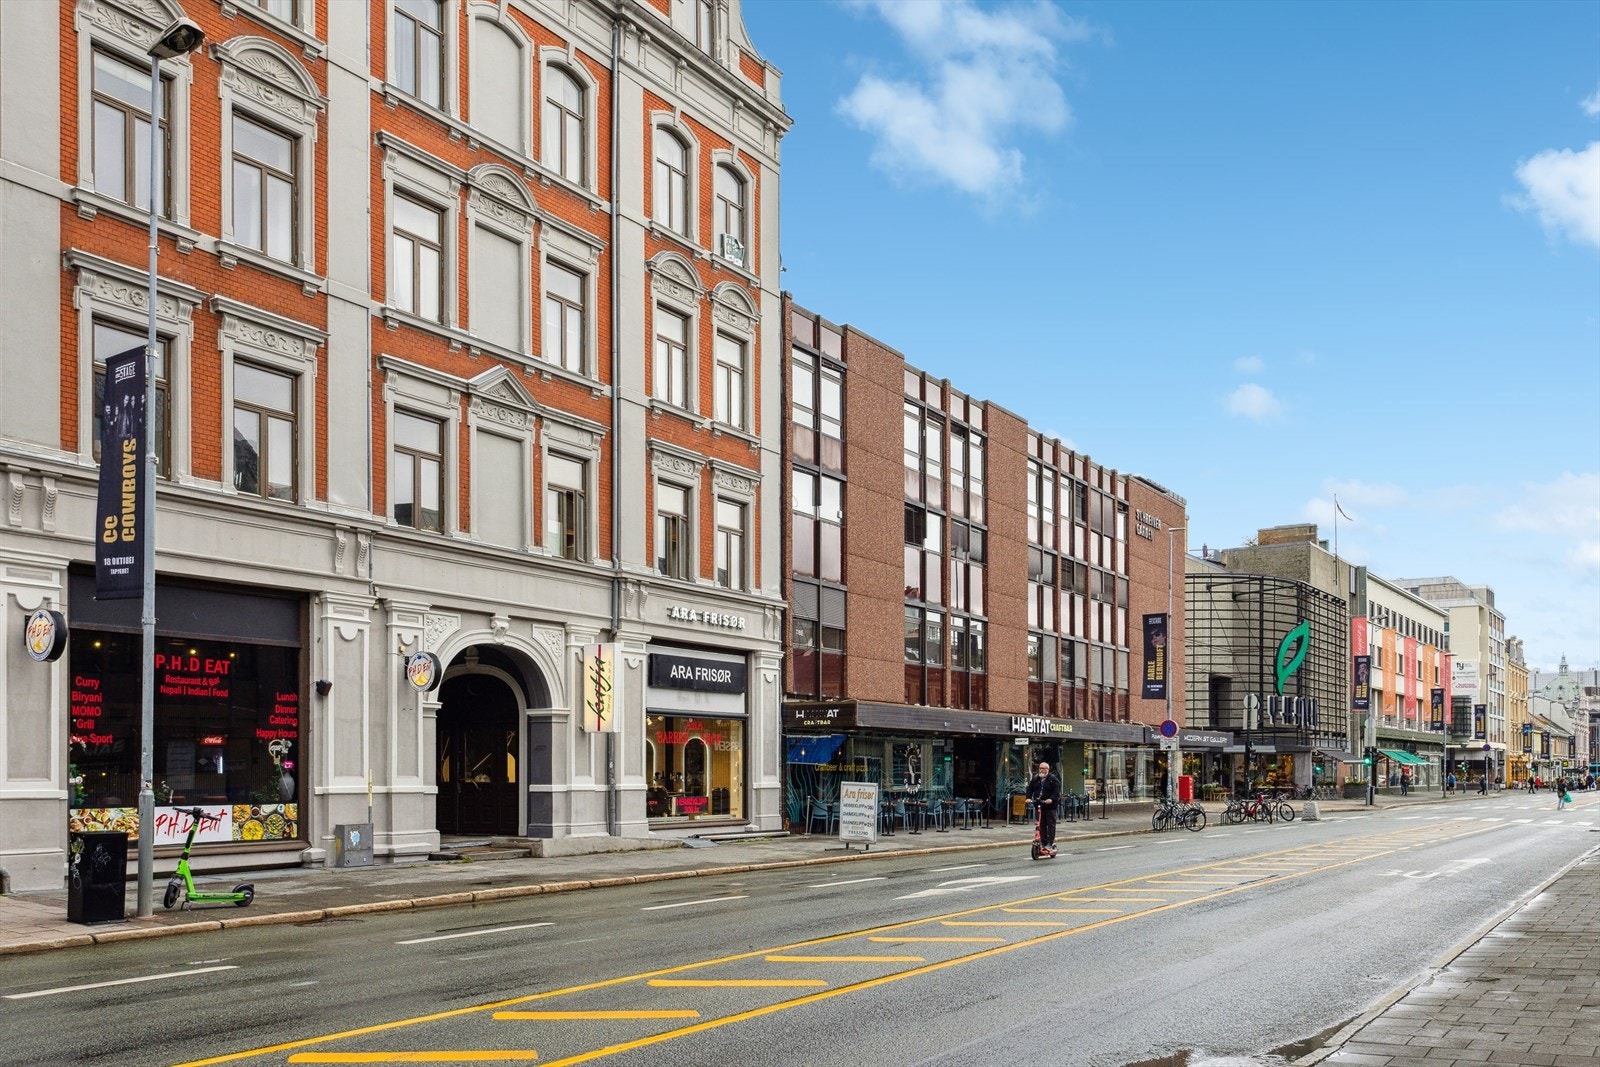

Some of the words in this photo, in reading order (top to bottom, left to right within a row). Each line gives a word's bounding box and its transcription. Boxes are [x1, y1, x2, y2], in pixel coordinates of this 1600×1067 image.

[122, 438, 136, 542] COWBOYS
[104, 514, 118, 544] CC
[671, 606, 697, 622] ARA
[703, 612, 746, 629] FRISØR
[155, 654, 200, 672] P.H.D
[205, 659, 230, 674] EAT
[165, 675, 201, 685] Restaurant
[671, 664, 693, 680] ARA
[695, 666, 732, 683] FRISØR
[75, 676, 100, 690] Curry
[72, 691, 103, 704] Biryani
[160, 685, 182, 695] Nepali
[188, 687, 208, 696] Indian
[213, 689, 228, 697] Food
[276, 692, 298, 702] Lunch
[72, 706, 101, 716] MOMO
[275, 705, 297, 714] Dinner
[1257, 694, 1318, 731] YHAVEN
[76, 719, 94, 729] Grill
[269, 715, 298, 727] Catering
[1011, 716, 1050, 734] HABITAT
[1050, 724, 1073, 732] CRAFTBAR
[256, 728, 277, 739] Happy
[278, 729, 297, 738] Hours
[657, 731, 689, 744] BARBER
[844, 788, 856, 799] Ara
